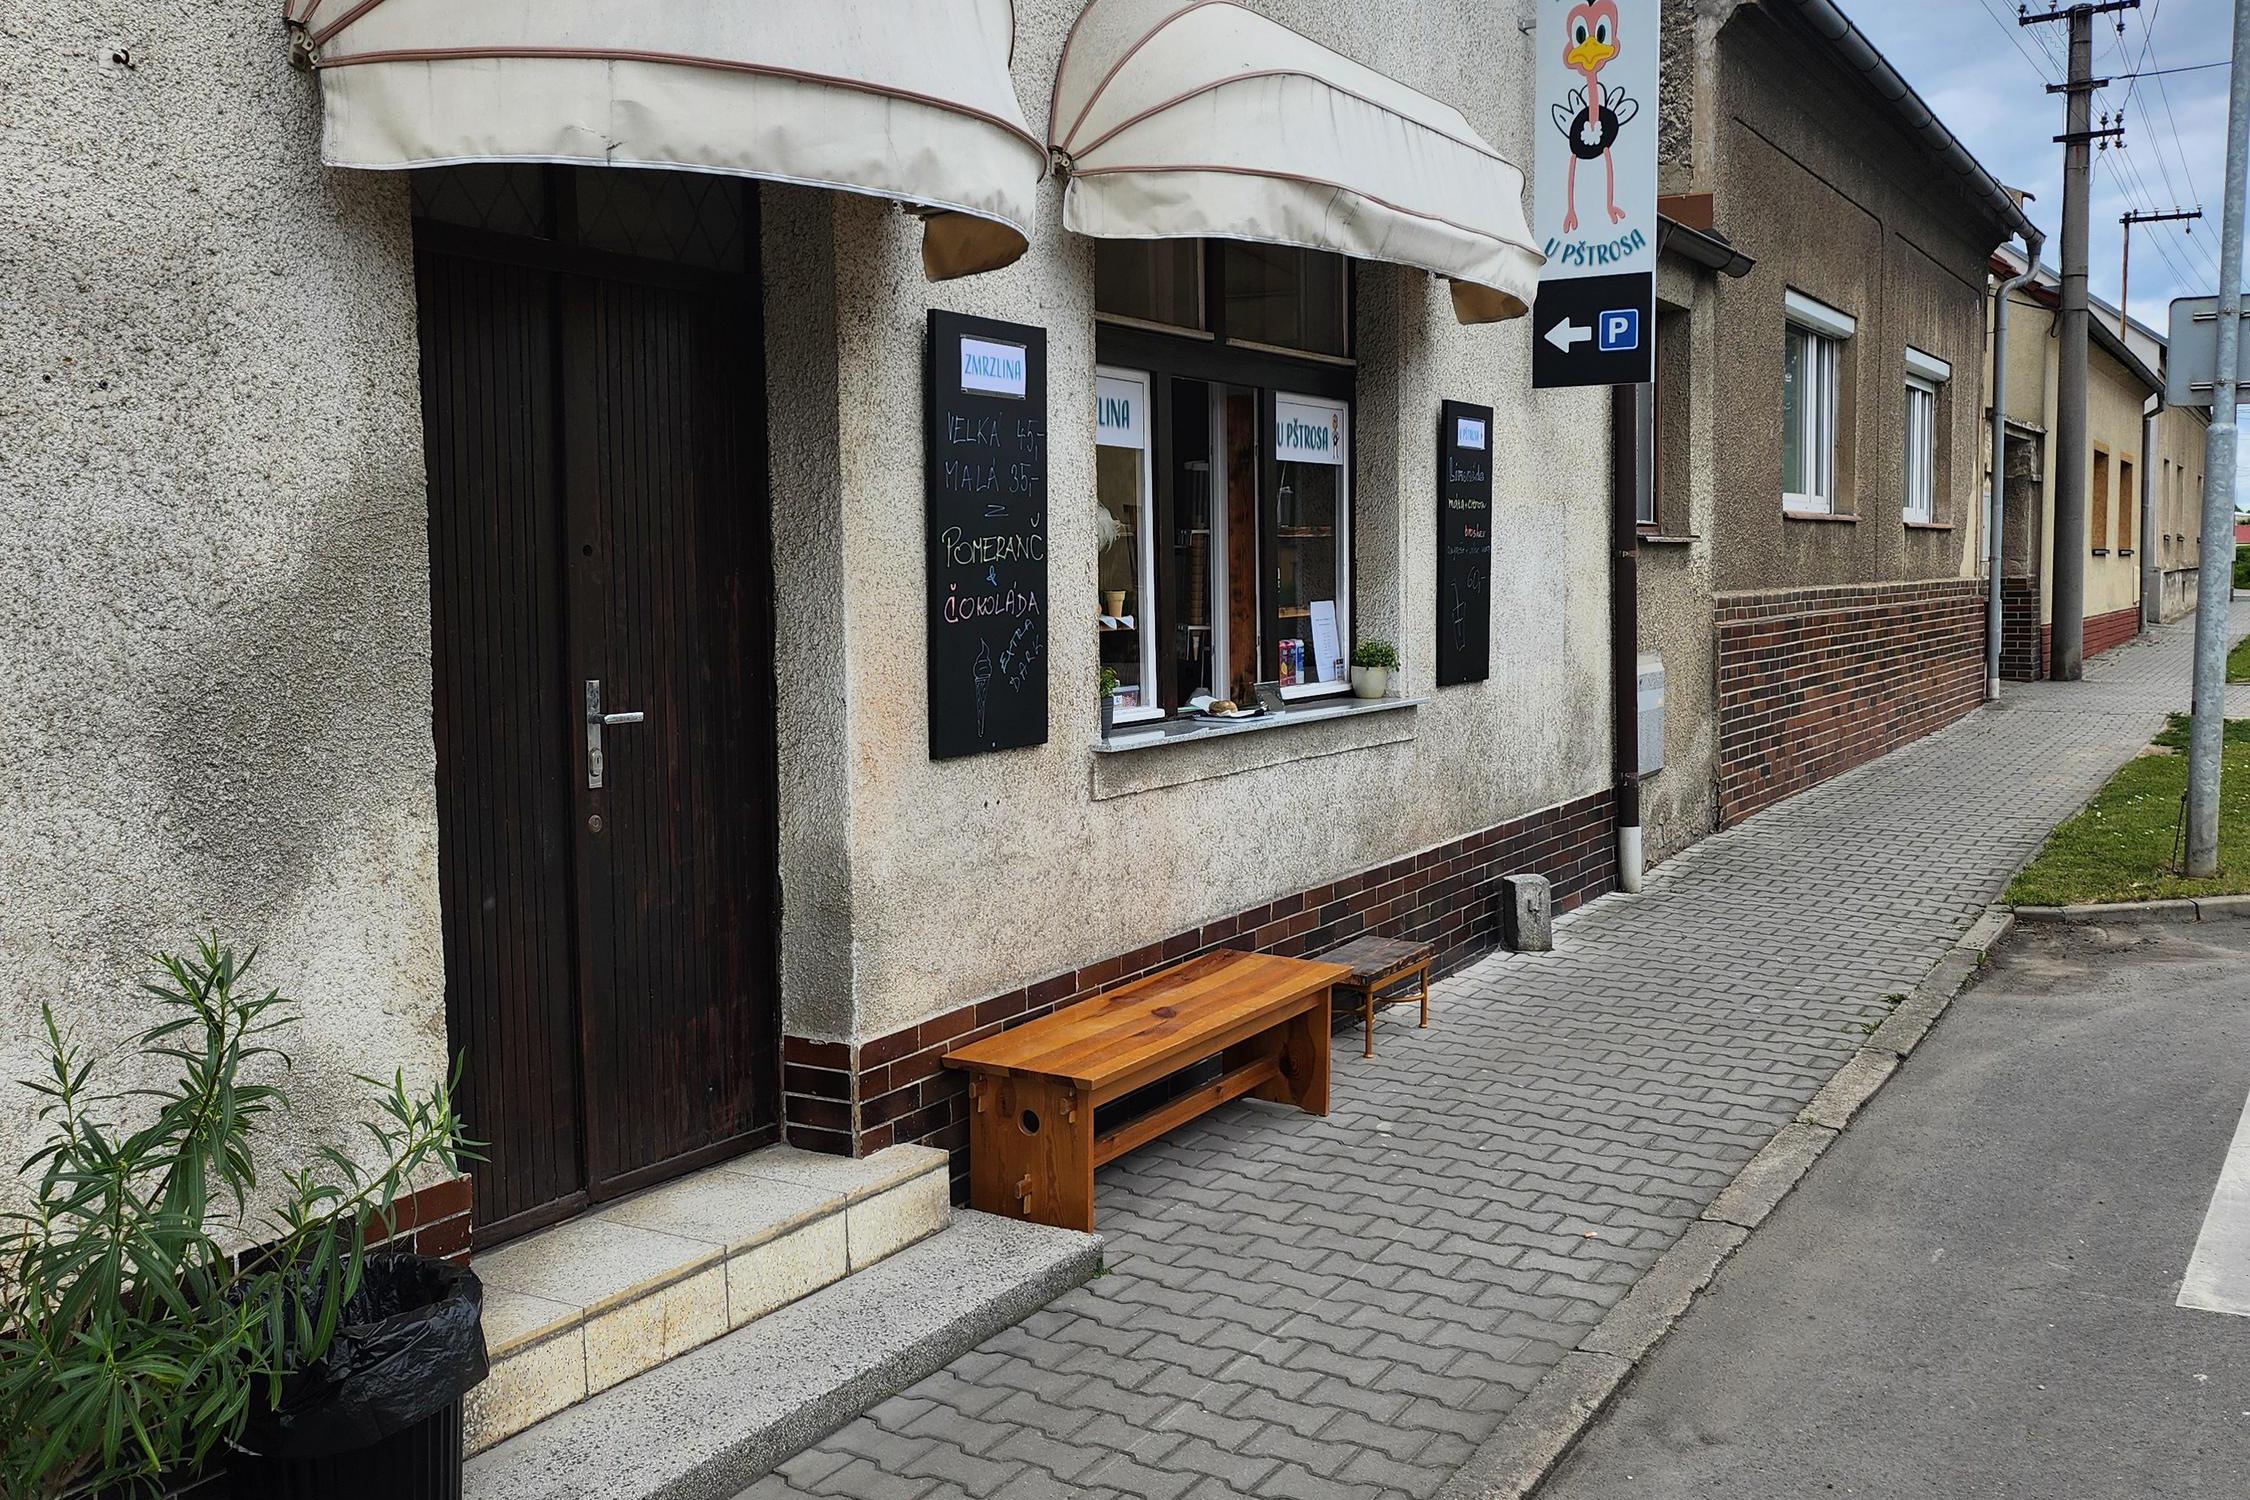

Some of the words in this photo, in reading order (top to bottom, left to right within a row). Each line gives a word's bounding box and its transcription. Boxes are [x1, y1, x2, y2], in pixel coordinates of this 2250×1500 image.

[1544, 237, 1560, 258] U
[1561, 228, 1646, 267] PŠTROSA
[1608, 317, 1629, 344] P
[964, 353, 1021, 381] ZMRZLINA
[947, 411, 1002, 447] VELKÁ
[1096, 396, 1130, 430] LINA
[1277, 421, 1284, 448] U
[1286, 417, 1329, 452] PŠTROSA
[945, 457, 1000, 491] MALÁ
[941, 512, 1044, 568] POMERANČ
[943, 581, 1040, 624] ČOKOLÁDA
[1000, 618, 1035, 674] EXTRA
[1009, 634, 1044, 693] DARK
